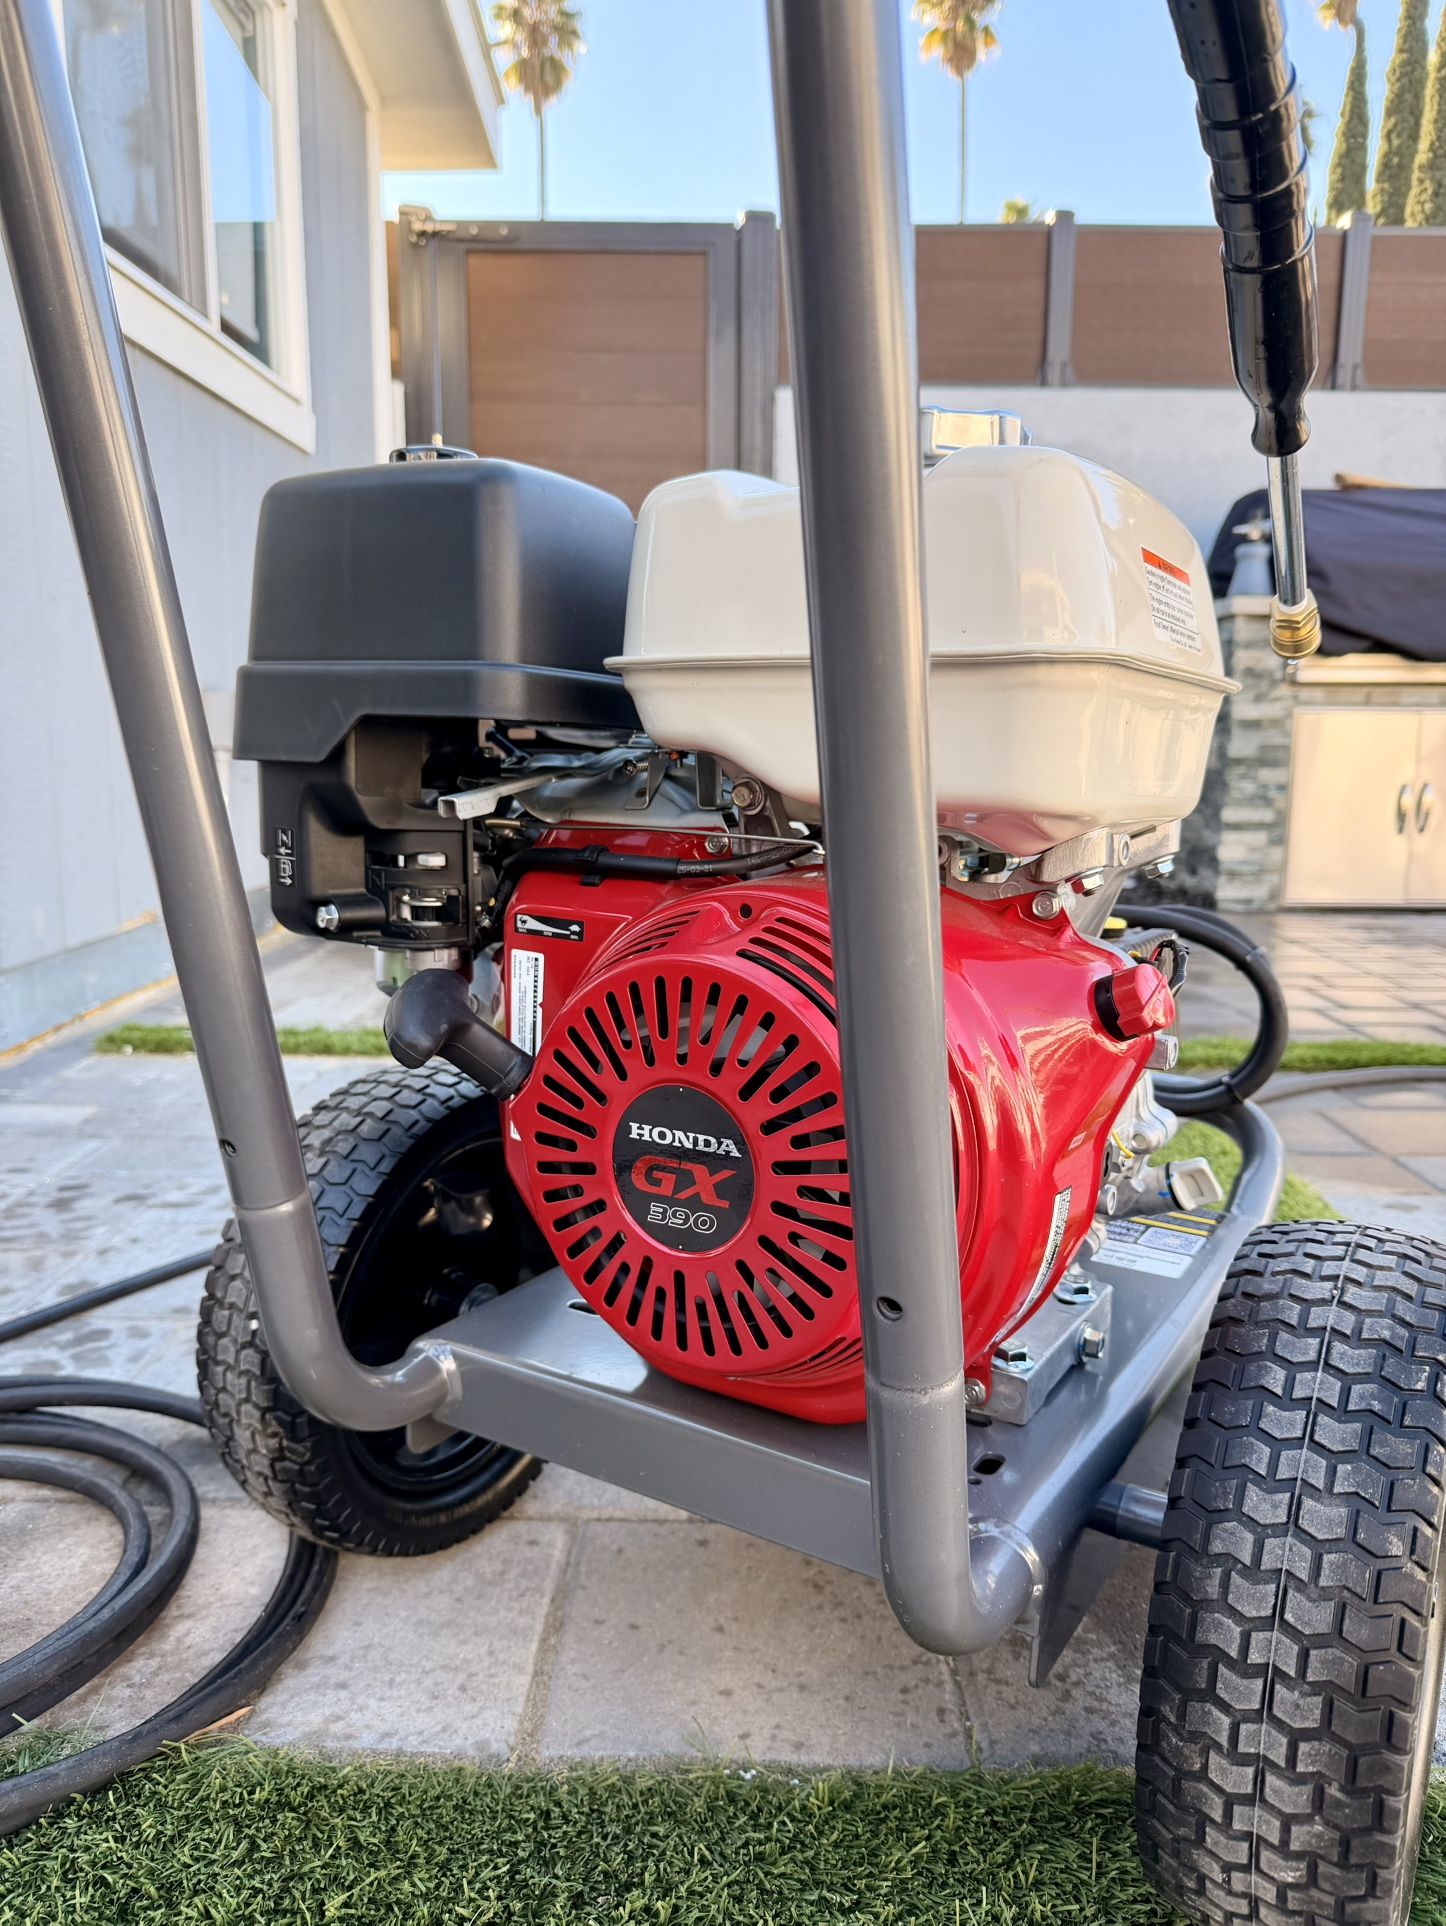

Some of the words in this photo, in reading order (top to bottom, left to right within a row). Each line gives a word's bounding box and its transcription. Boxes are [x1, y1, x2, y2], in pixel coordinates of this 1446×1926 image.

[629, 1122, 742, 1158] HONDA
[631, 1155, 737, 1208] GX
[648, 1202, 717, 1234] 390
